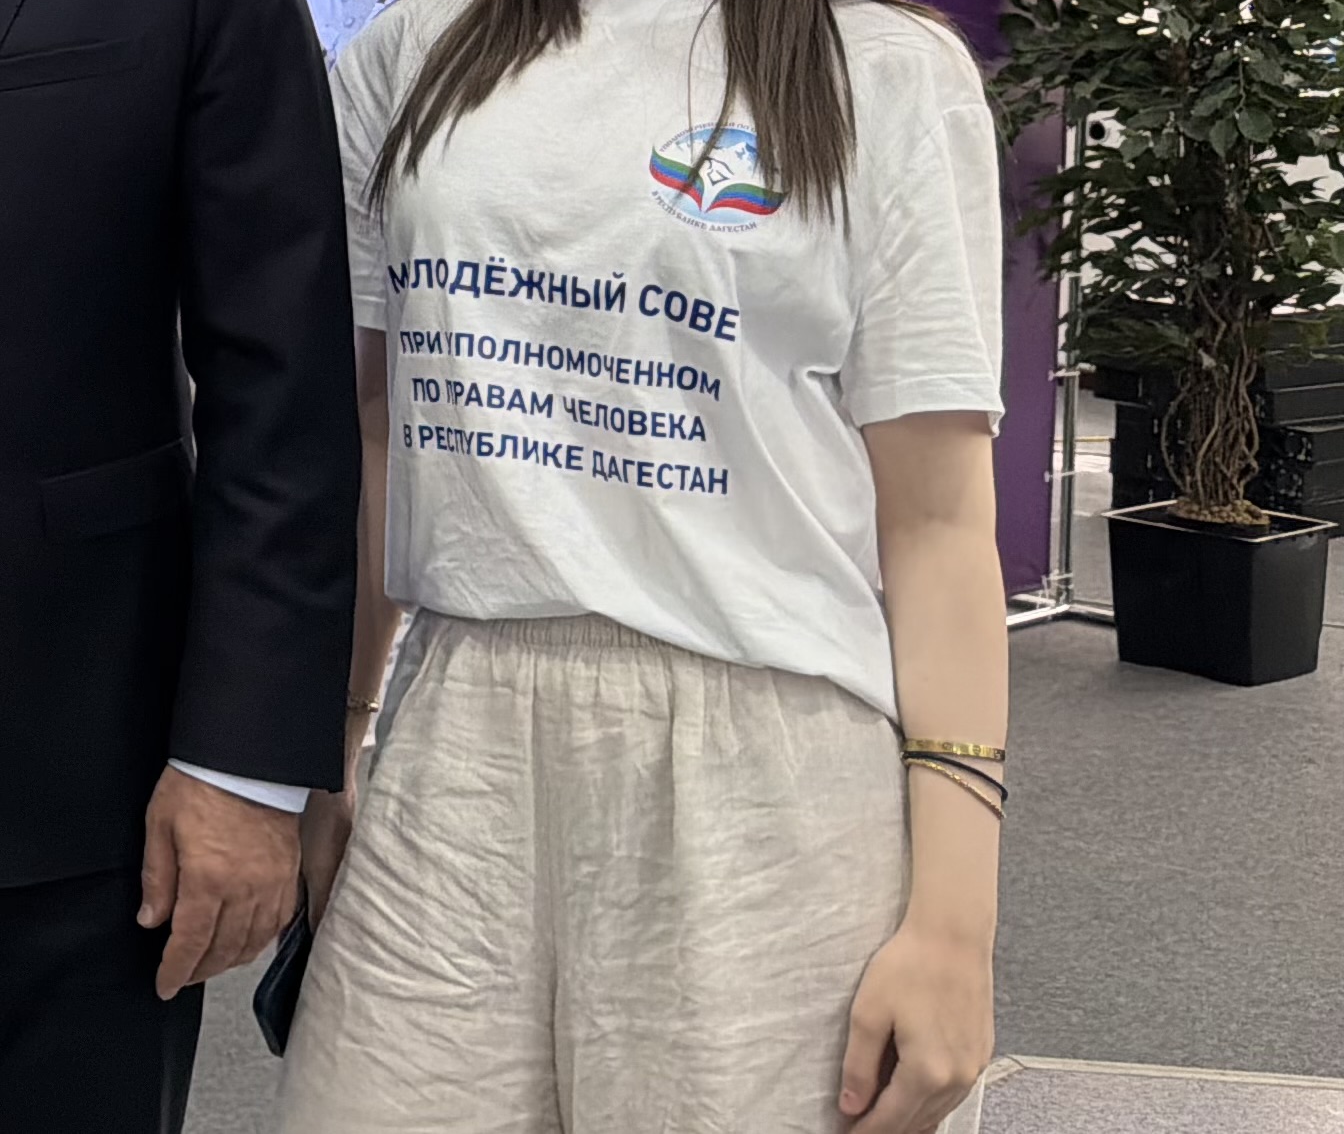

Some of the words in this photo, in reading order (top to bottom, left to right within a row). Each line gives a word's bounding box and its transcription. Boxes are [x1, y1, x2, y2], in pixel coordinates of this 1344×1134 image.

[387, 256, 627, 313] МЛОДЁЖНЫЙ
[639, 284, 741, 342] СОВЕ
[400, 331, 442, 354] ПРИ
[444, 331, 721, 401] УПОЛНОМОЧЕННОМ
[412, 378, 440, 403] ПО
[445, 379, 554, 418] ПРАВАМ
[563, 395, 707, 442] ЧЕЛОВЕКА
[404, 424, 412, 449] В
[419, 425, 584, 471] РЕСПУБЛИКЕ
[591, 450, 729, 495] ДАГЕСТАН
